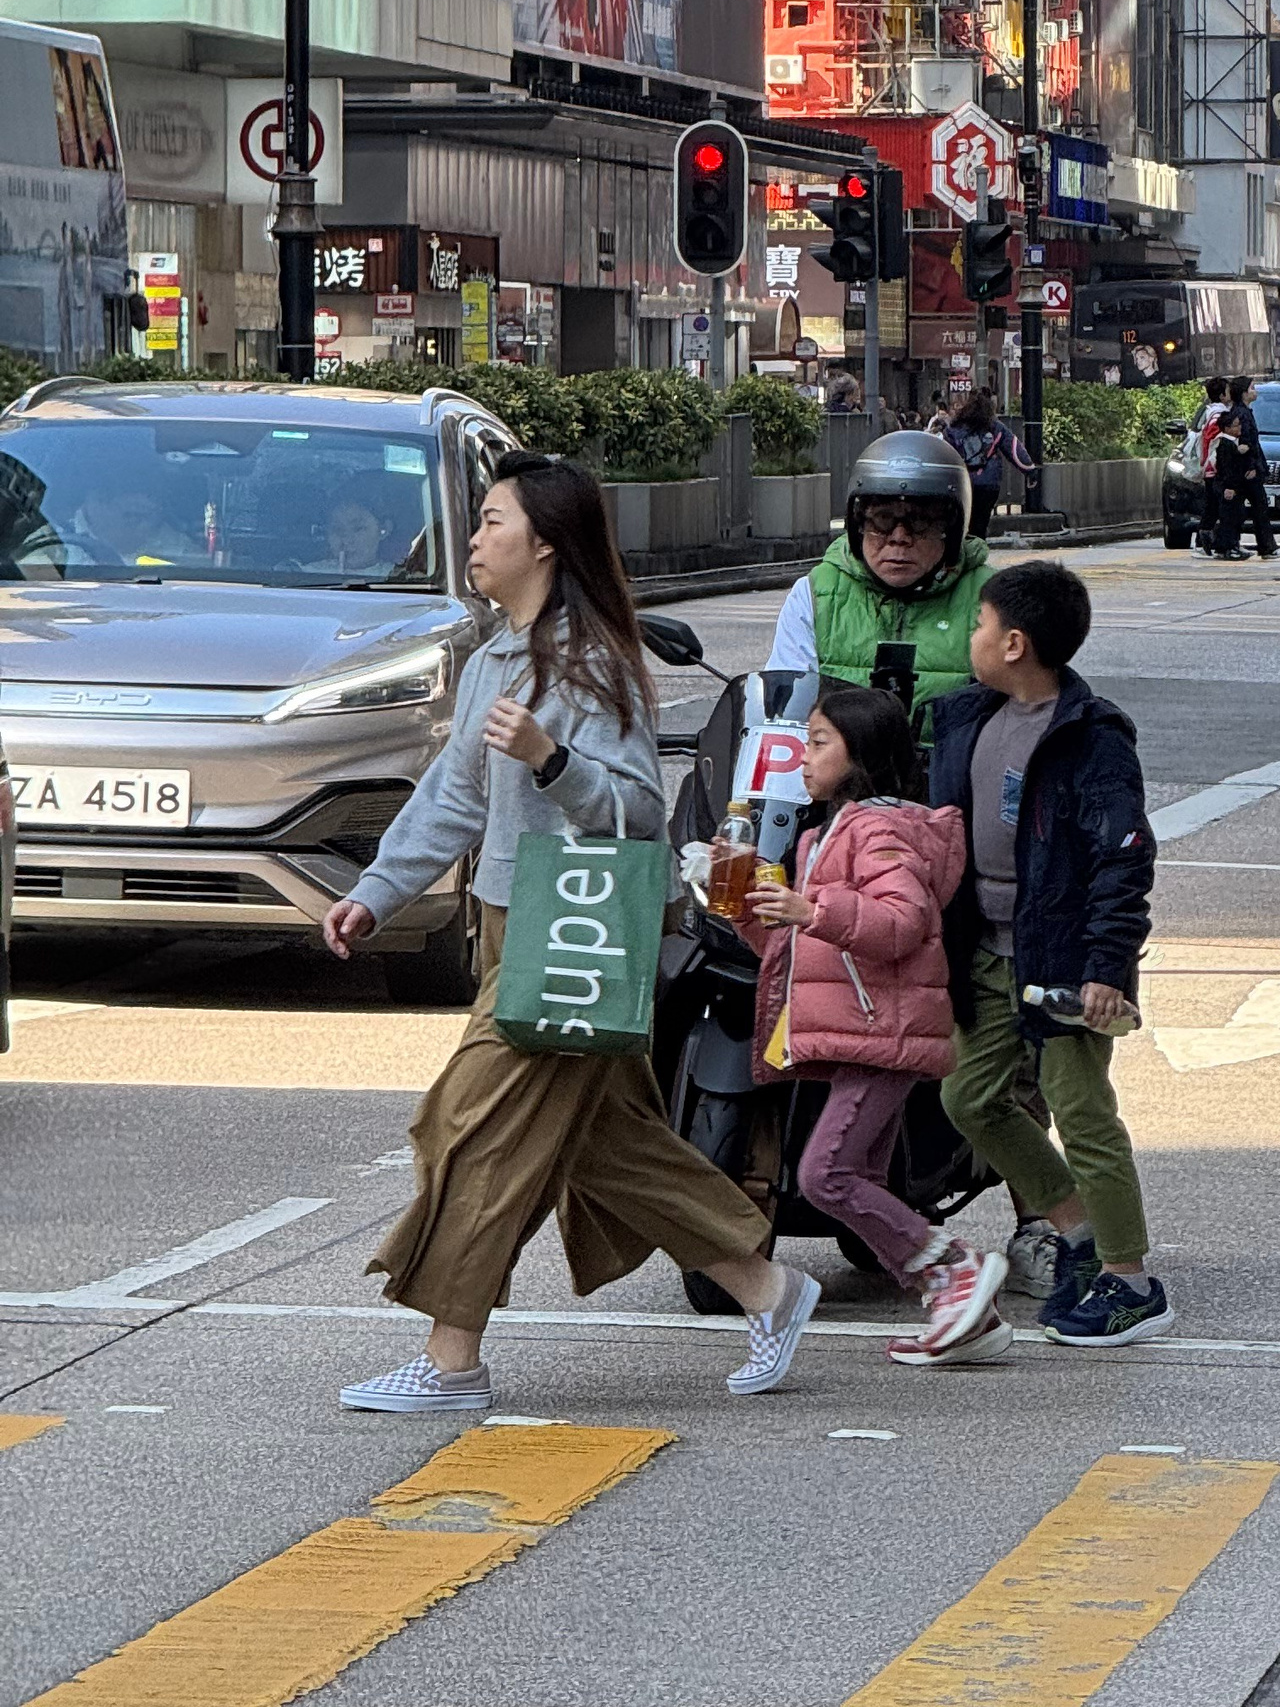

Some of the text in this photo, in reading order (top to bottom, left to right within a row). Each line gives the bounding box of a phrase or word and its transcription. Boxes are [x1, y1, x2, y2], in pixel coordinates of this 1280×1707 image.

[766, 244, 802, 287] 寶
[942, 330, 978, 344] 六福珠
[1122, 330, 1137, 343] 112
[949, 380, 972, 392] N55
[750, 733, 808, 792] P
[82, 780, 181, 814] 4518
